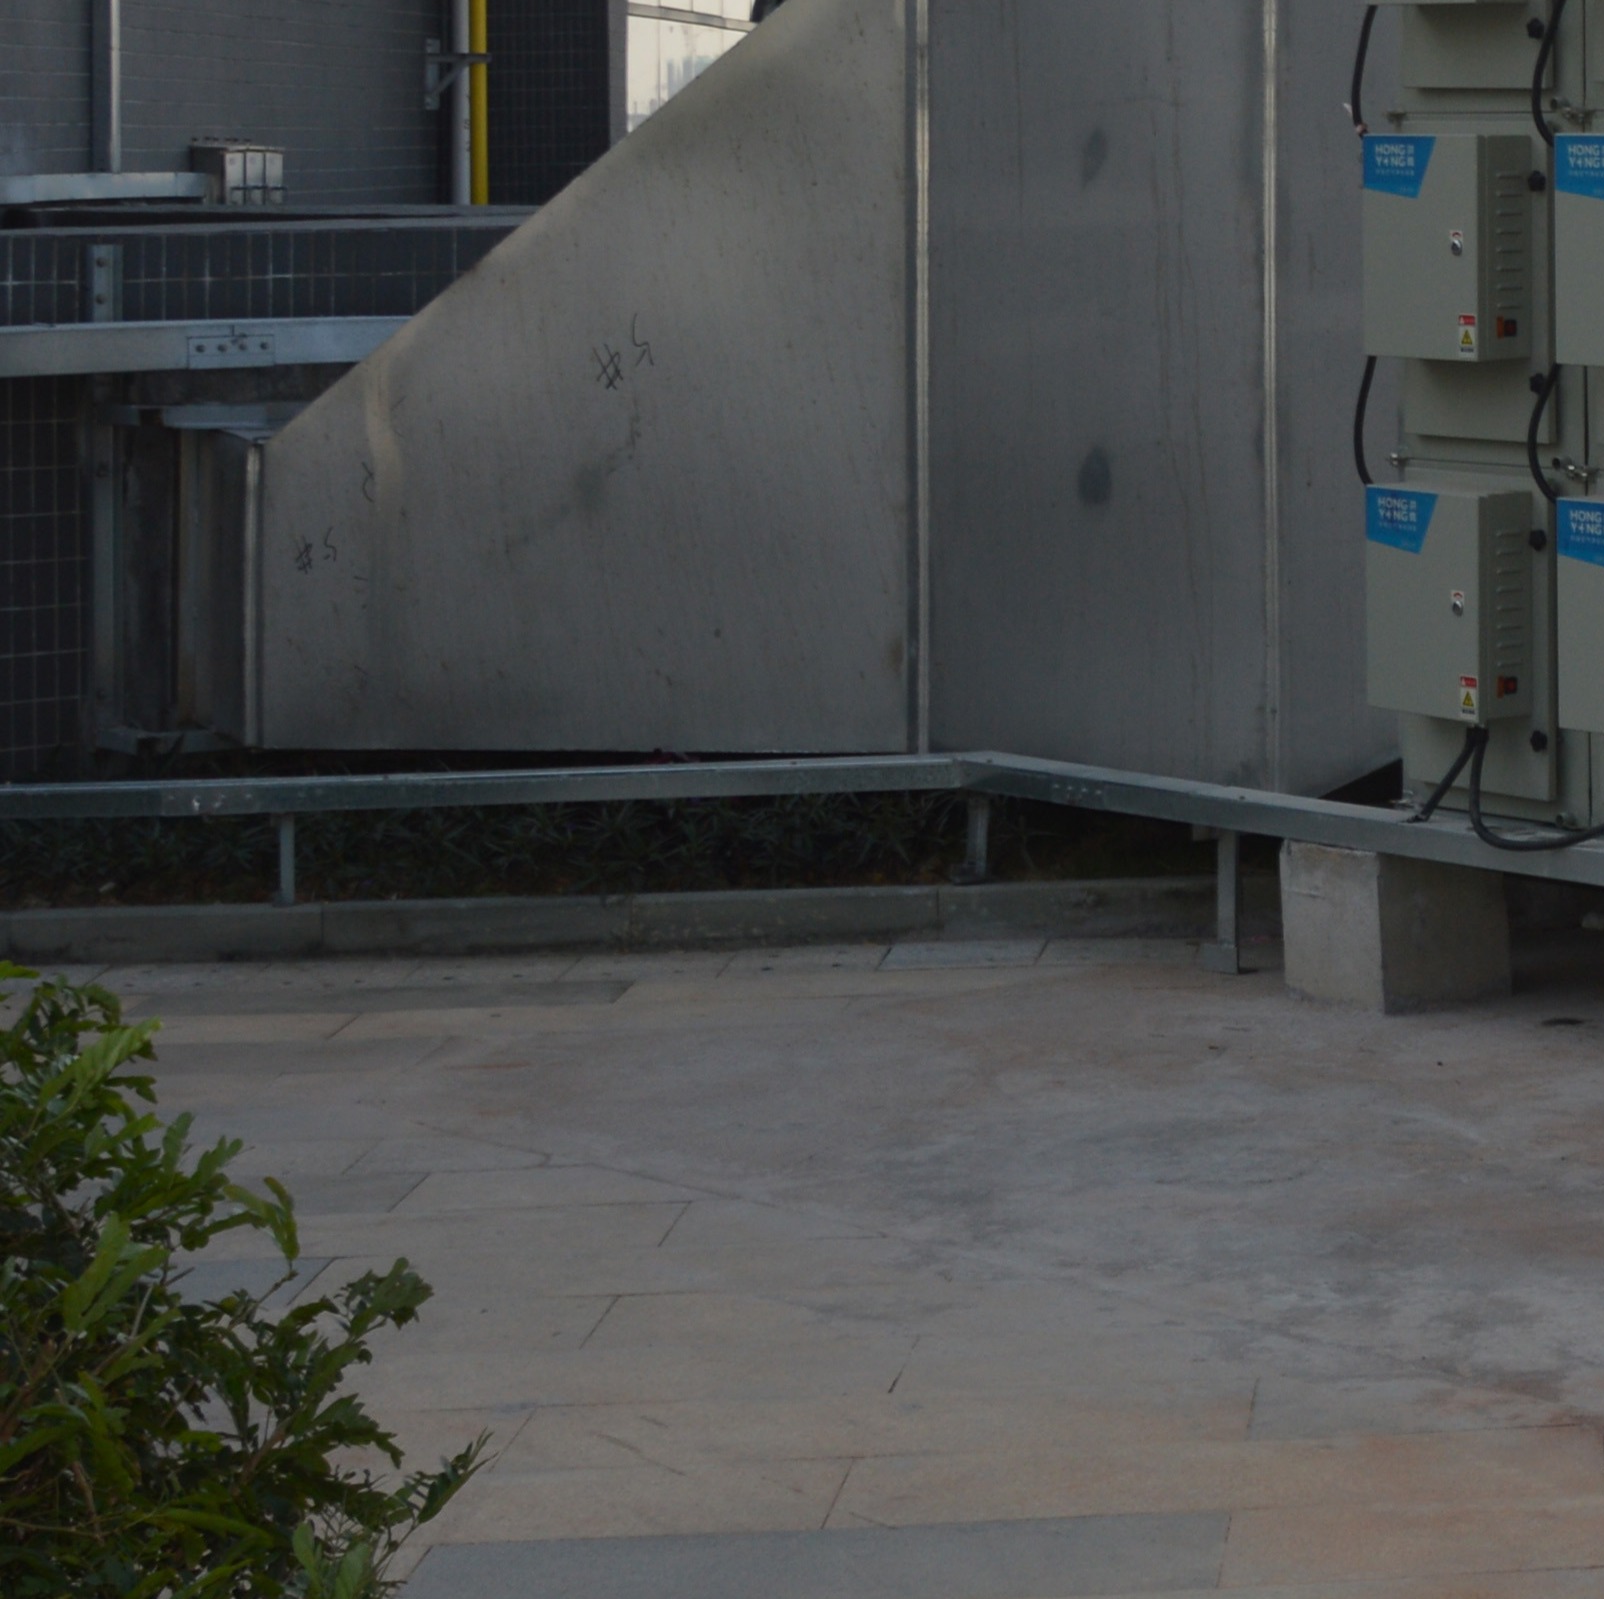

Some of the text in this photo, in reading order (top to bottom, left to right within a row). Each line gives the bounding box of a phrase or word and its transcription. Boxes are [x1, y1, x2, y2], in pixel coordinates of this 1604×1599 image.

[1375, 143, 1405, 155] HONG
[1567, 144, 1599, 156] HONG
[1377, 497, 1407, 508] HONG
[1569, 510, 1601, 522] HONG
